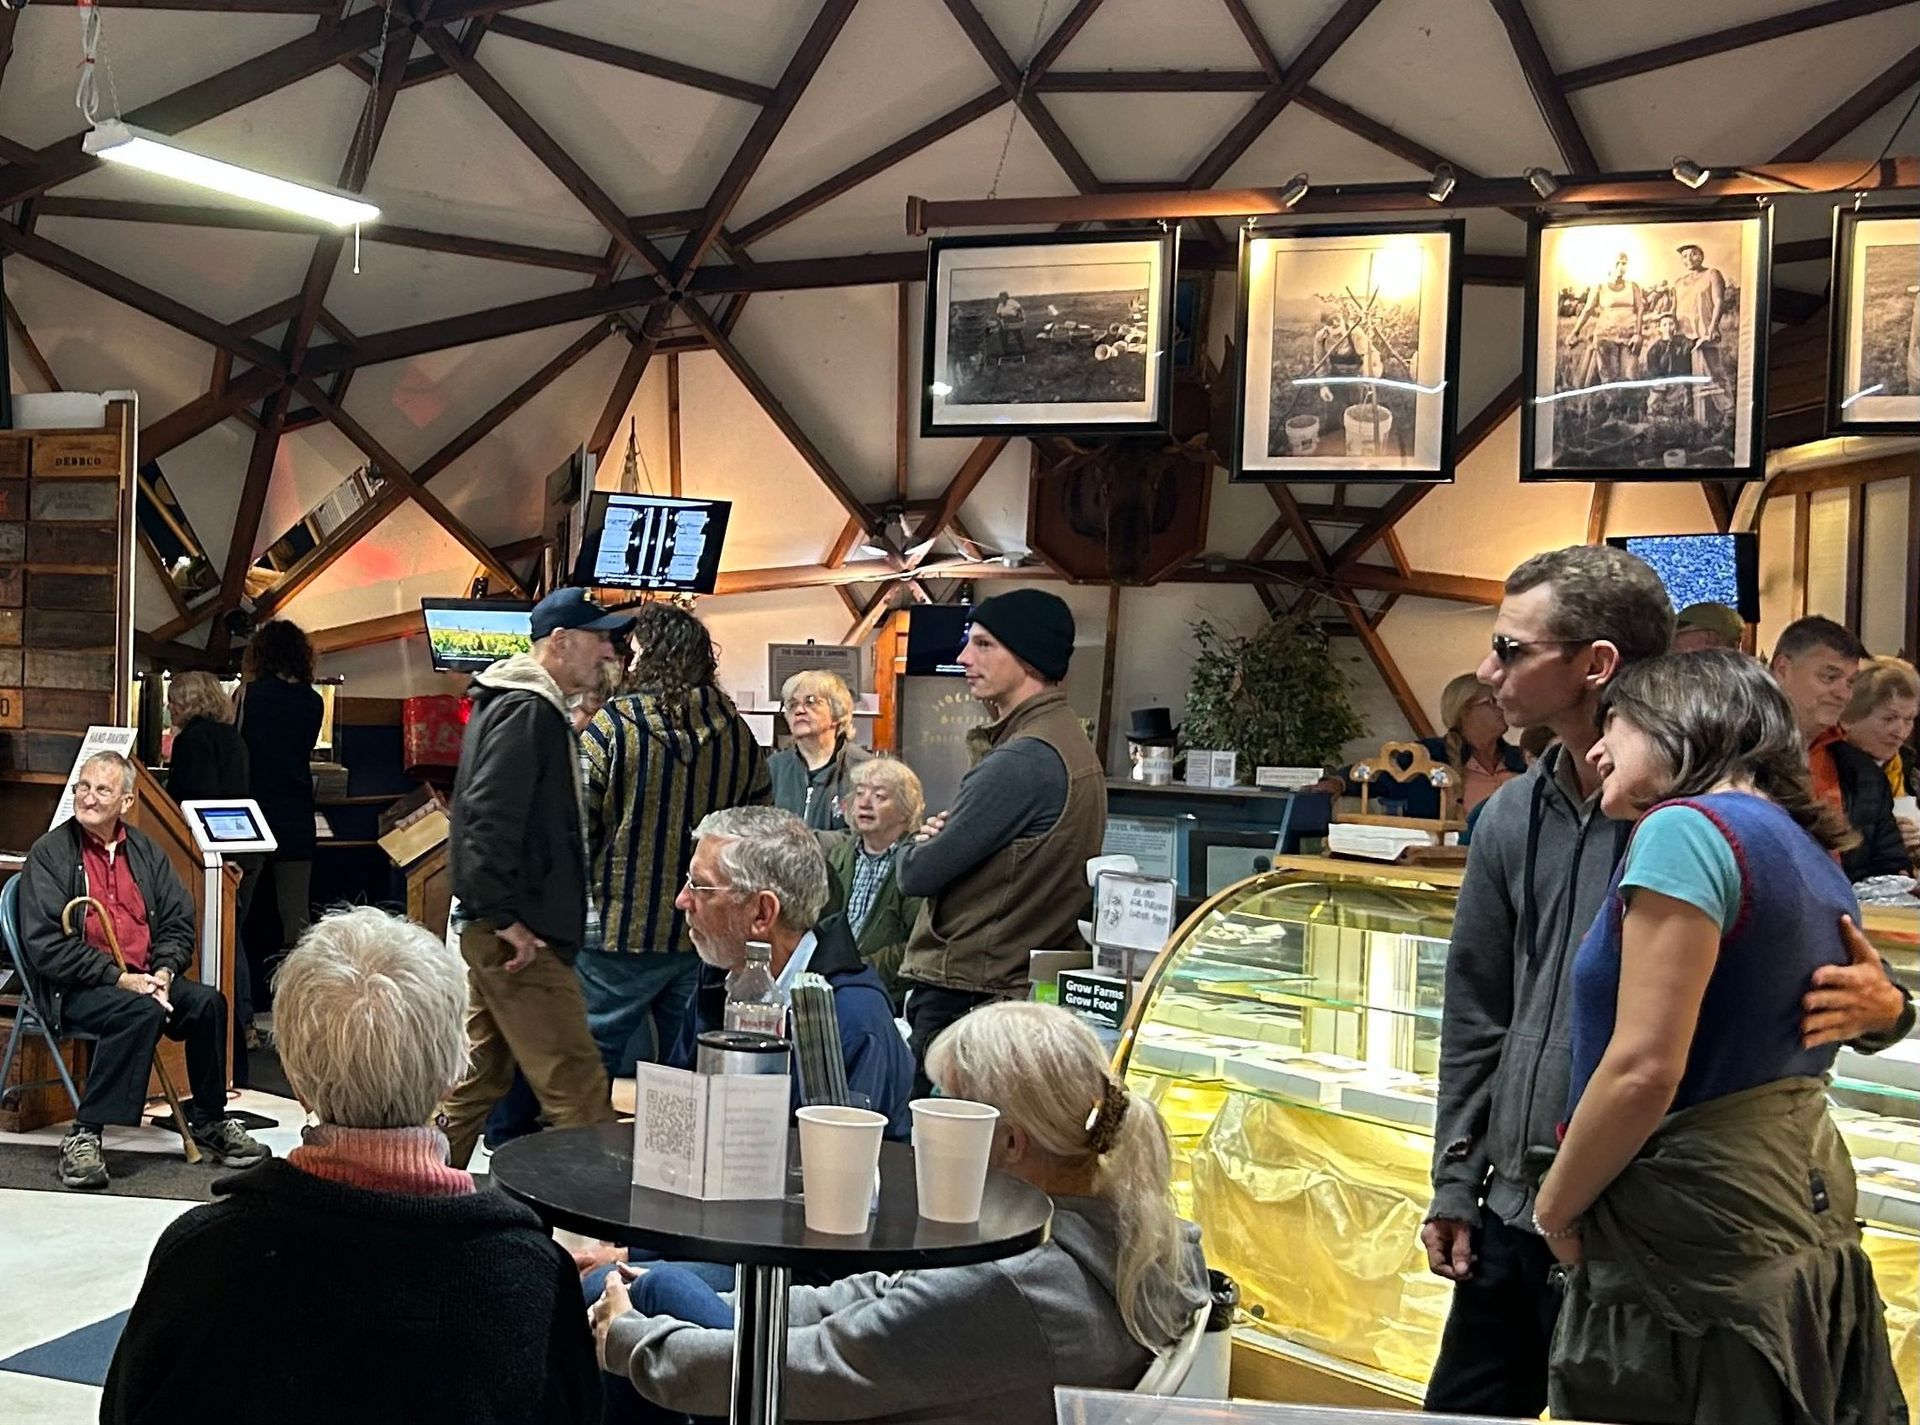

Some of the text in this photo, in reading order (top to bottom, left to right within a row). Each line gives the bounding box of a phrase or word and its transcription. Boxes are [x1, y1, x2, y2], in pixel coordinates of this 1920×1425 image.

[1066, 980, 1124, 1000] Grow Farms
[1065, 993, 1117, 1011] Grow Food
